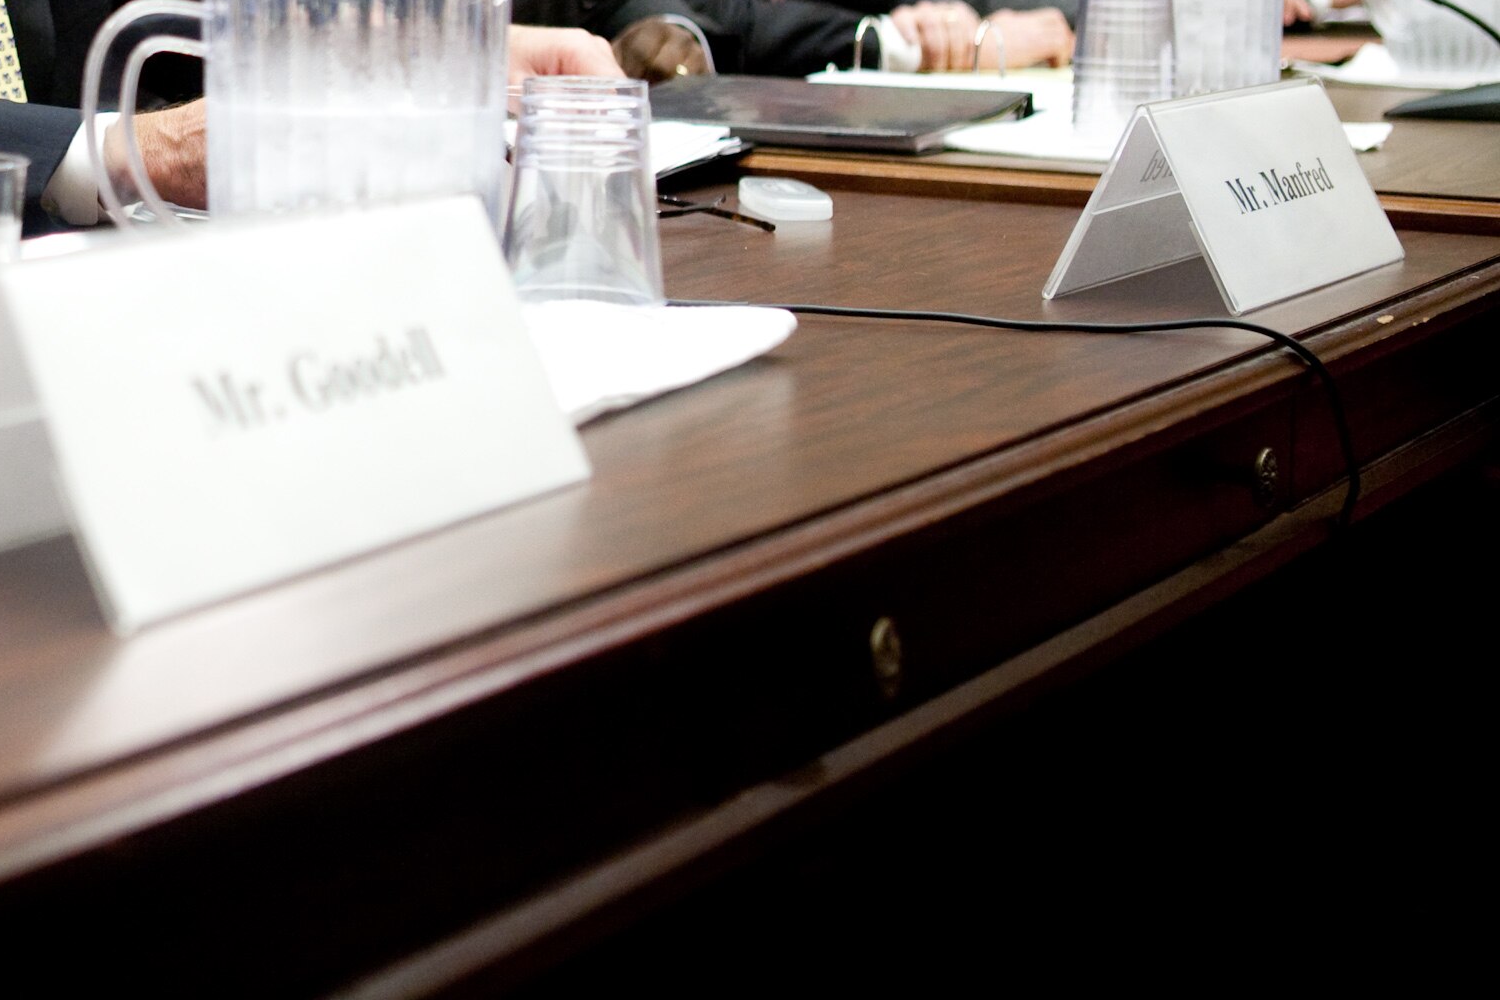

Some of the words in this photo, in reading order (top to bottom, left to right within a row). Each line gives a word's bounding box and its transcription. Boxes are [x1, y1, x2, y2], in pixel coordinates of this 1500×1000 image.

[1225, 178, 1268, 214] Mr.
[1259, 157, 1334, 205] Manfred
[189, 369, 287, 436] Mr.
[286, 326, 446, 411] Goodell
